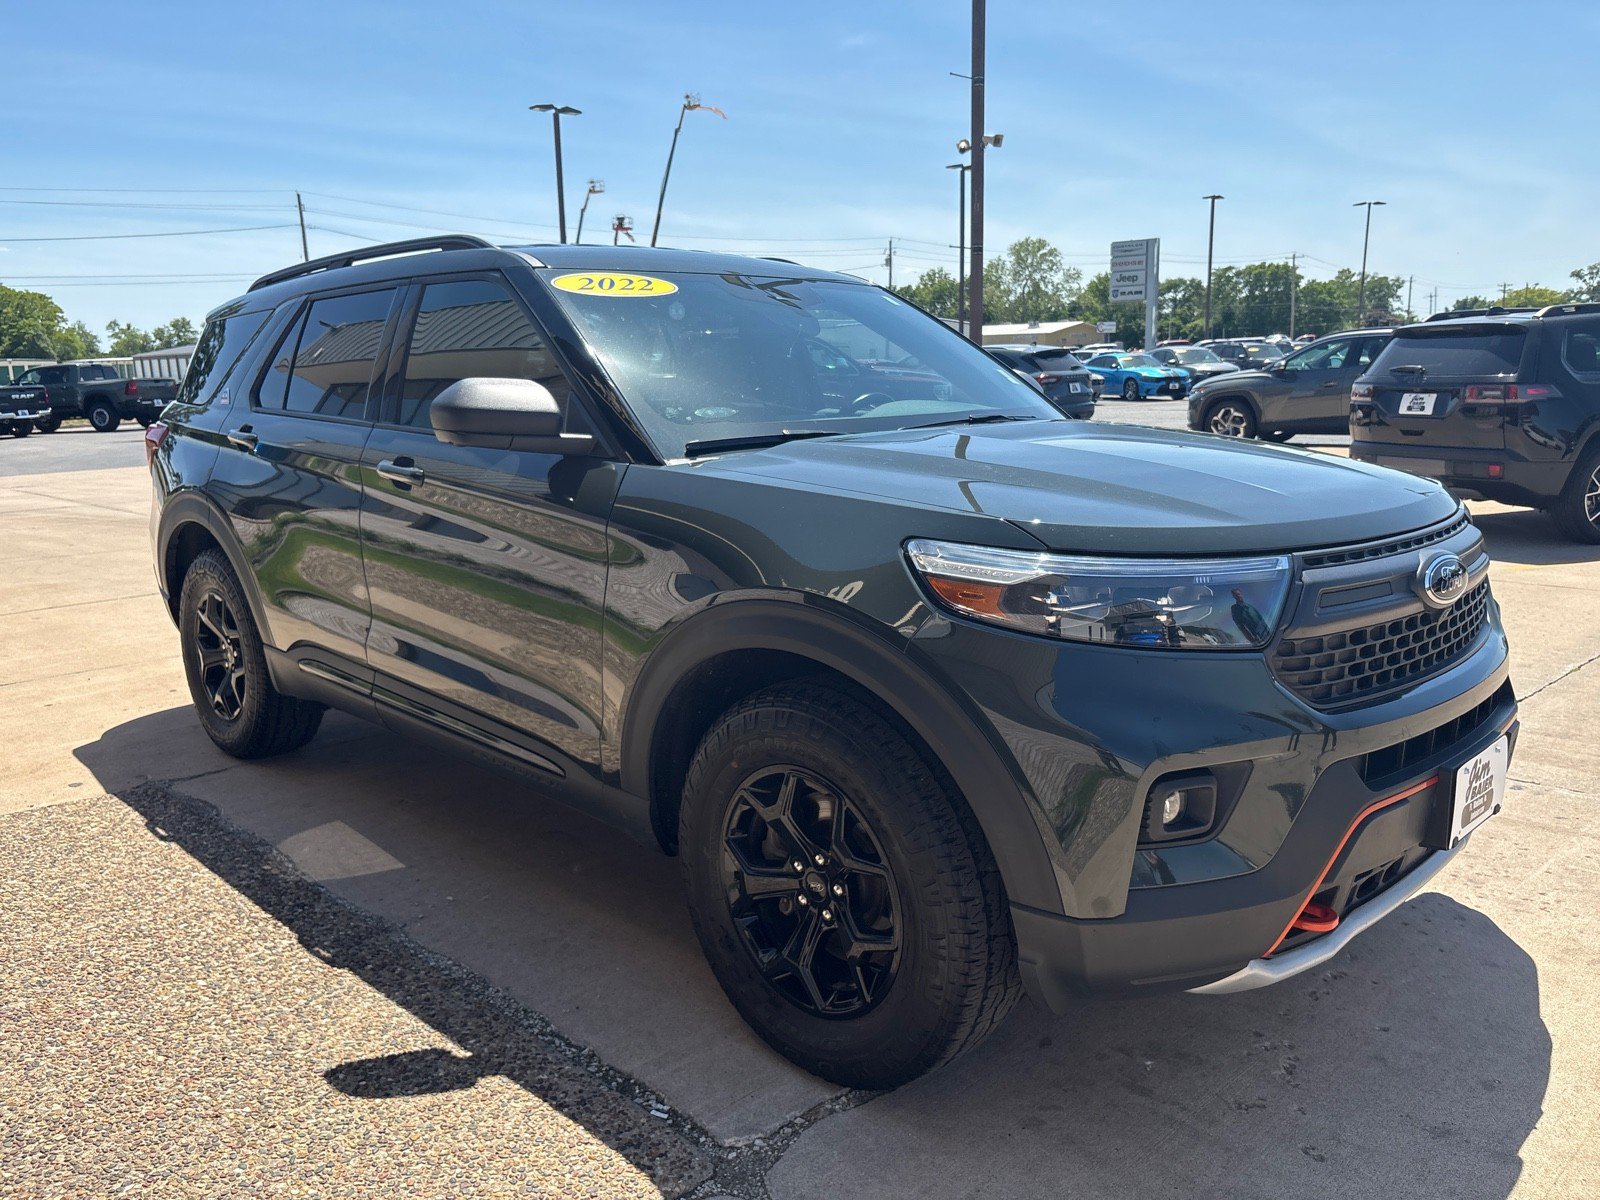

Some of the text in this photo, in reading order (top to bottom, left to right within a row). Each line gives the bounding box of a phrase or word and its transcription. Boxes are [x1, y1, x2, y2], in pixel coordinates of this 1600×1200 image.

[578, 277, 654, 291] 2022
[1115, 273, 1138, 283] Jeep
[931, 560, 1015, 579] EXPLORER
[1440, 564, 1463, 594] Ford
